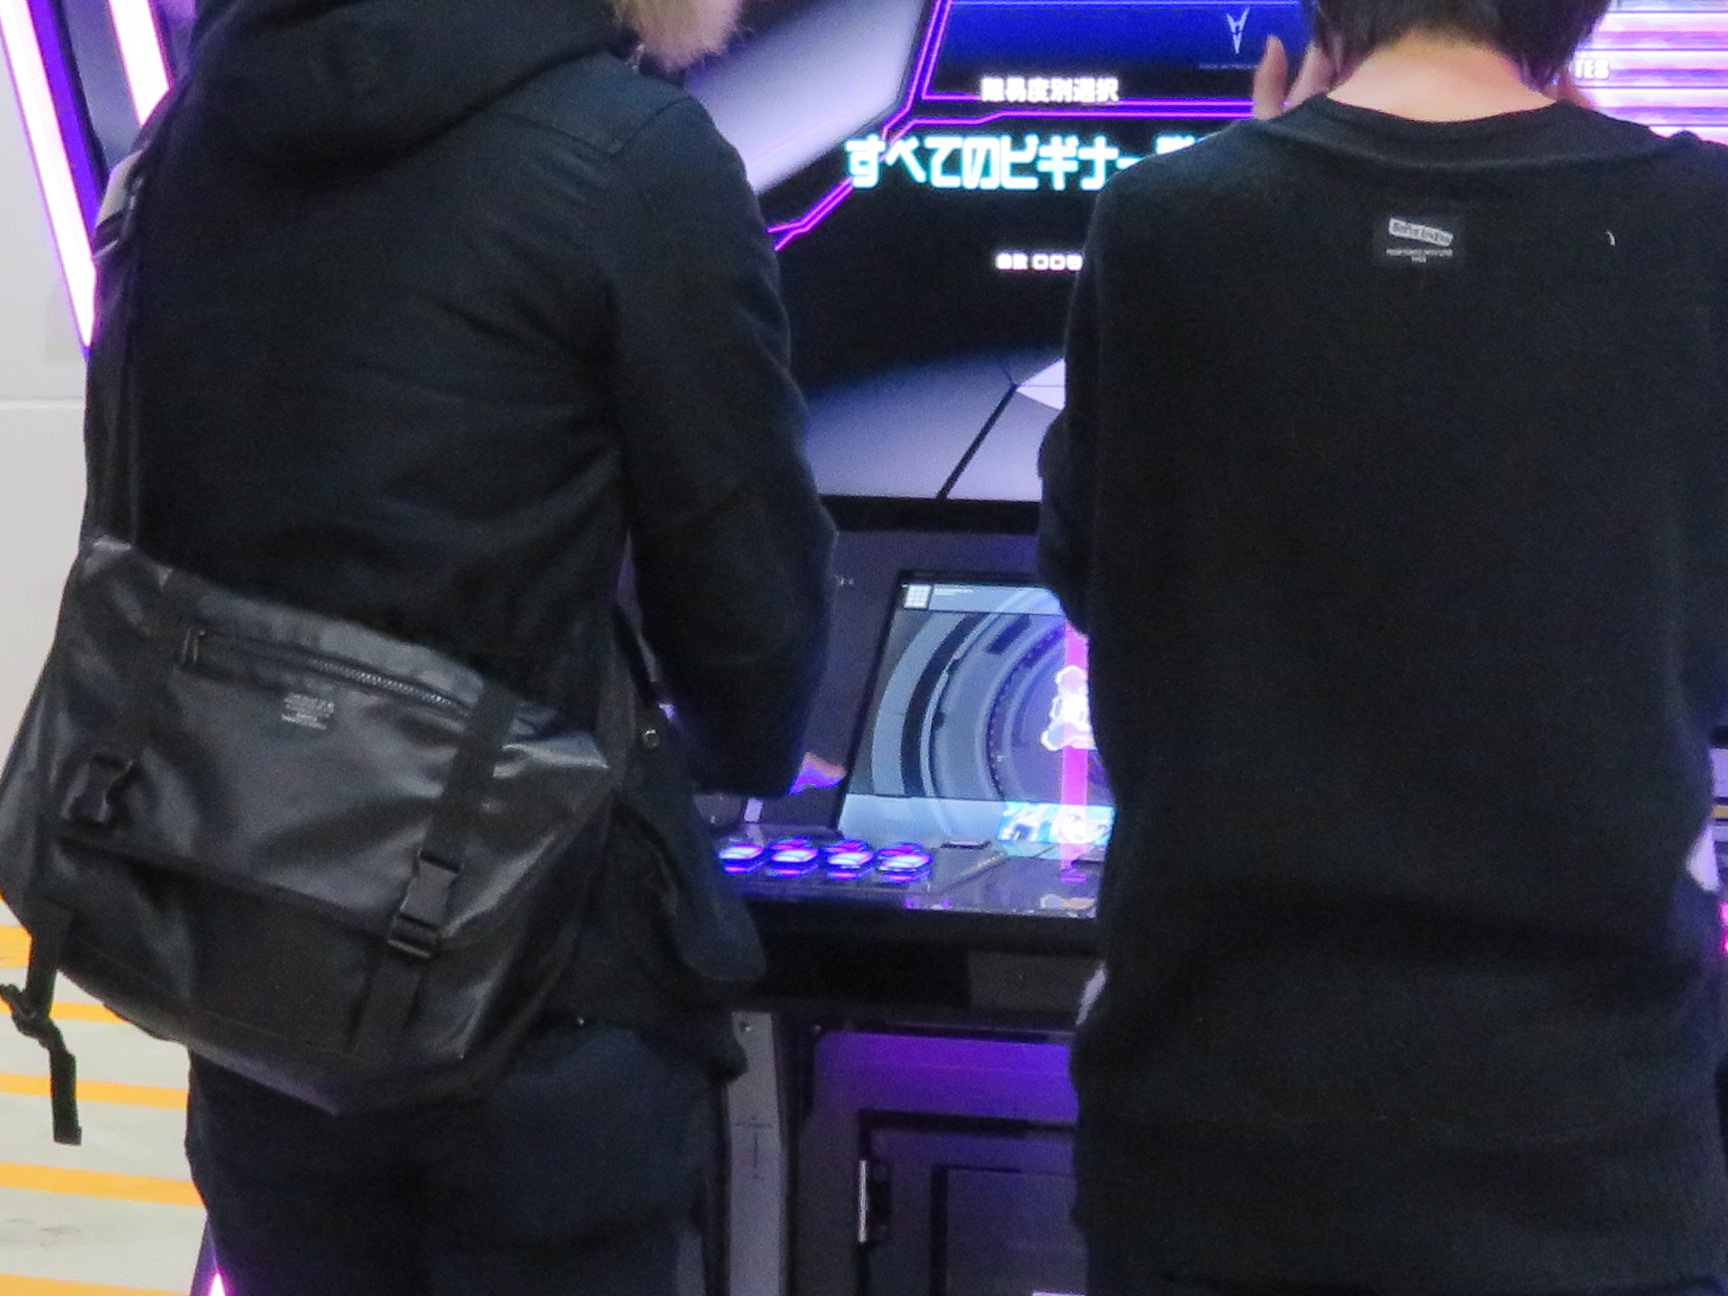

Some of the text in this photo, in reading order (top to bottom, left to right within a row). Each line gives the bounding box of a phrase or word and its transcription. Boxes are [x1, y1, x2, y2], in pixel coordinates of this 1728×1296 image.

[980, 76, 1120, 104] 難易度別選択
[844, 133, 1197, 190] すべてのビギナー
